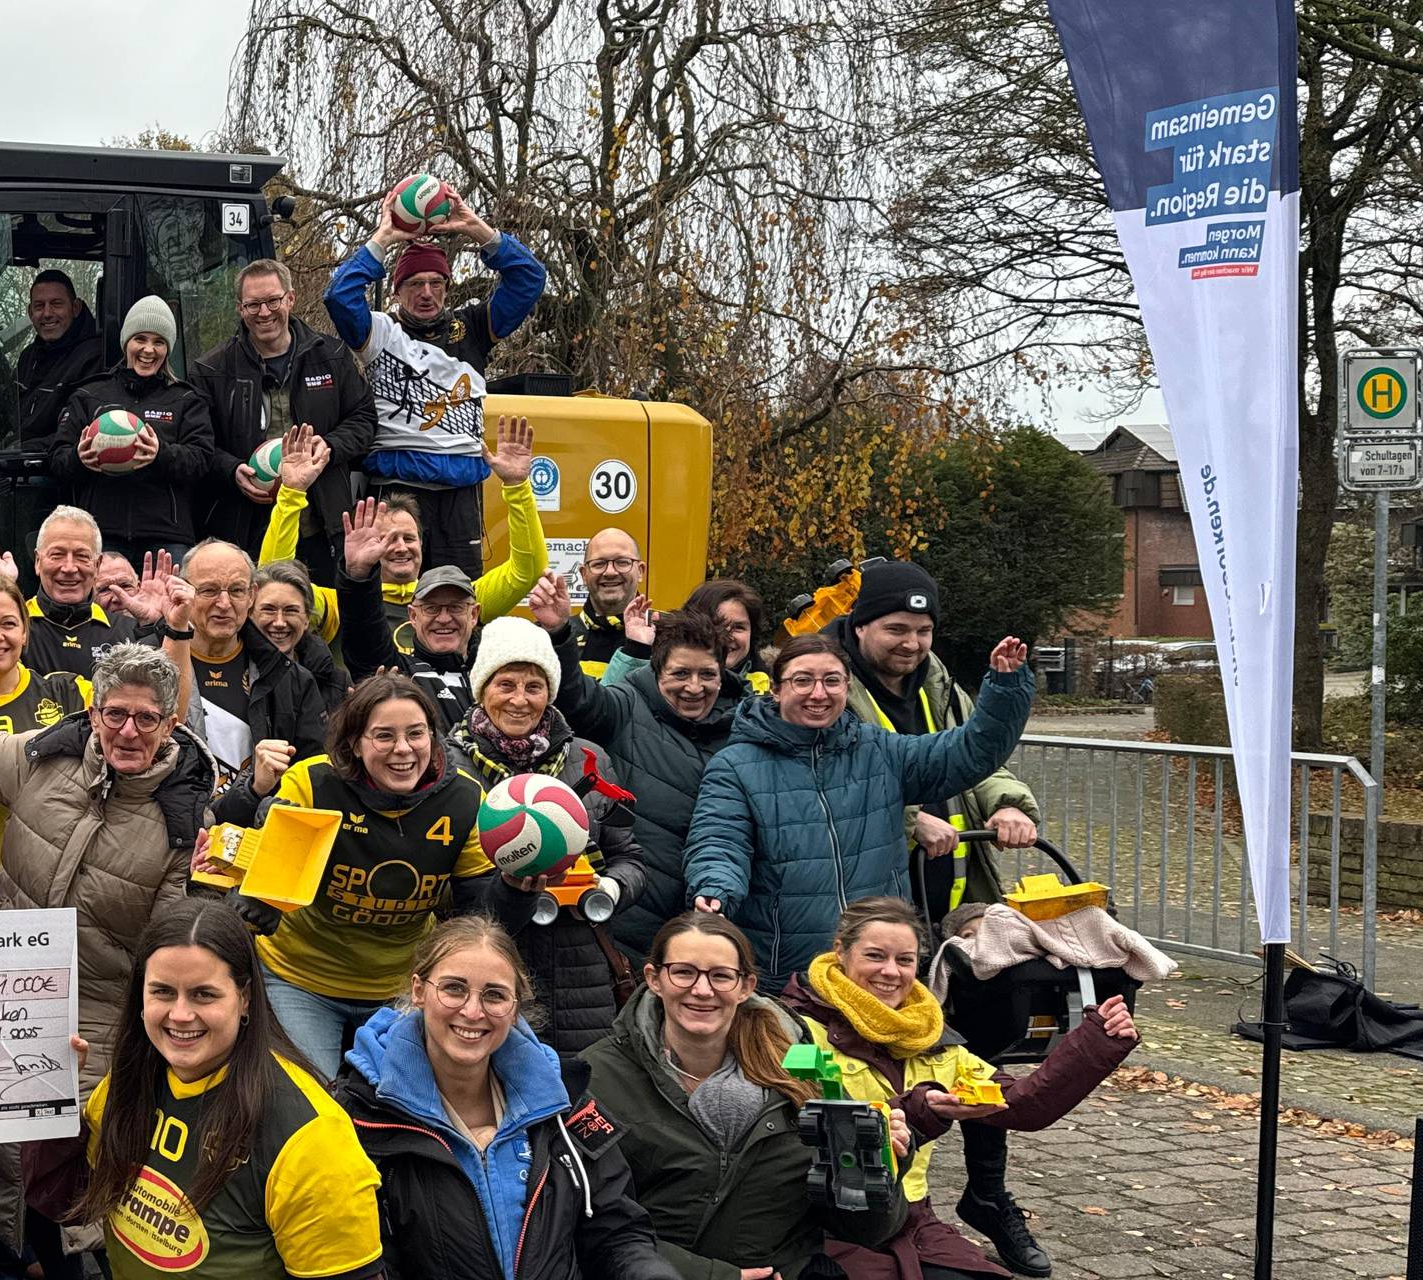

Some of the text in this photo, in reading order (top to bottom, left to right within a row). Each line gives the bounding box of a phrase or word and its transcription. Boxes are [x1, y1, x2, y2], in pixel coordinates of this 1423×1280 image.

[229, 211, 243, 227] 34
[305, 373, 332, 383] RADIO
[1372, 378, 1393, 408] H
[1365, 450, 1413, 462] Schultagen
[1360, 467, 1376, 476] von
[595, 471, 631, 500] 30
[342, 823, 369, 834] erma
[425, 815, 455, 846] 4
[498, 841, 538, 866] molten
[330, 860, 452, 901] SPORT
[28, 932, 50, 947] eG
[150, 1108, 188, 1162] 10
[120, 1190, 191, 1244] rampe
